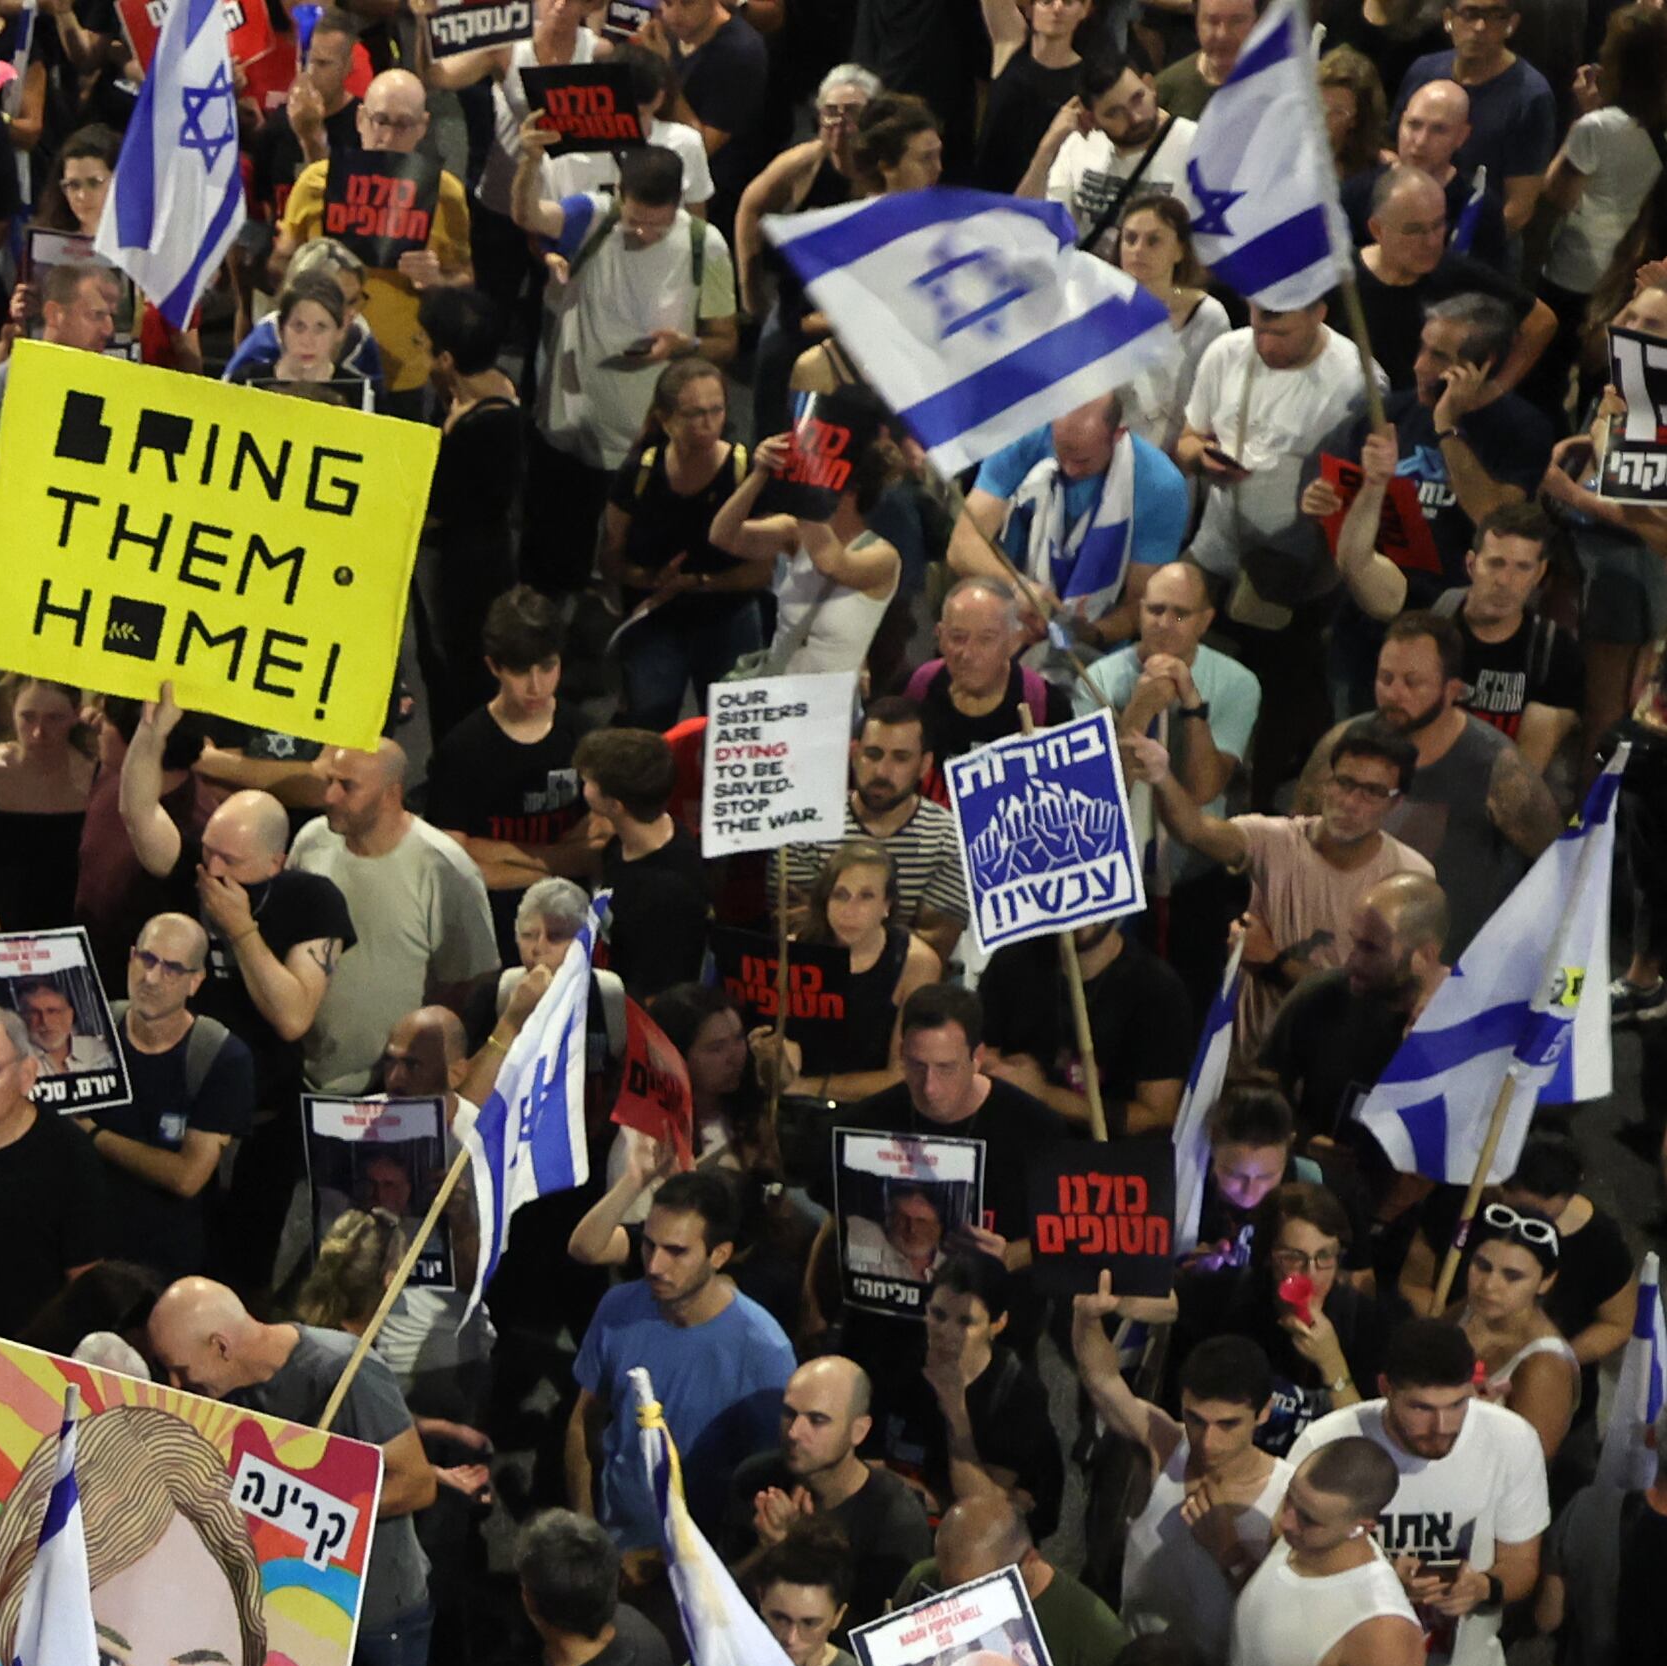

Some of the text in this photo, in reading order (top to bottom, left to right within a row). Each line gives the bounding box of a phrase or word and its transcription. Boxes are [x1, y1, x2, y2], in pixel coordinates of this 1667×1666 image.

[348, 174, 416, 208] כולנו
[328, 200, 429, 241] חטופים
[53, 389, 365, 517] BRING
[46, 486, 307, 607] THEM
[715, 702, 808, 727] SISTERS
[716, 690, 769, 709] OUR
[715, 726, 762, 744] ARE
[714, 742, 789, 763] DYING
[958, 724, 1108, 800] בחירות
[716, 761, 783, 780] TO BE
[713, 778, 795, 800] SAVED.
[711, 807, 824, 836] THE WAR.
[712, 798, 770, 818] STOP
[988, 860, 1119, 931] עכשיו!
[1057, 1174, 1148, 1215] כולנו
[1035, 1213, 1171, 1257] חטופים
[239, 1470, 346, 1562] קרינה
